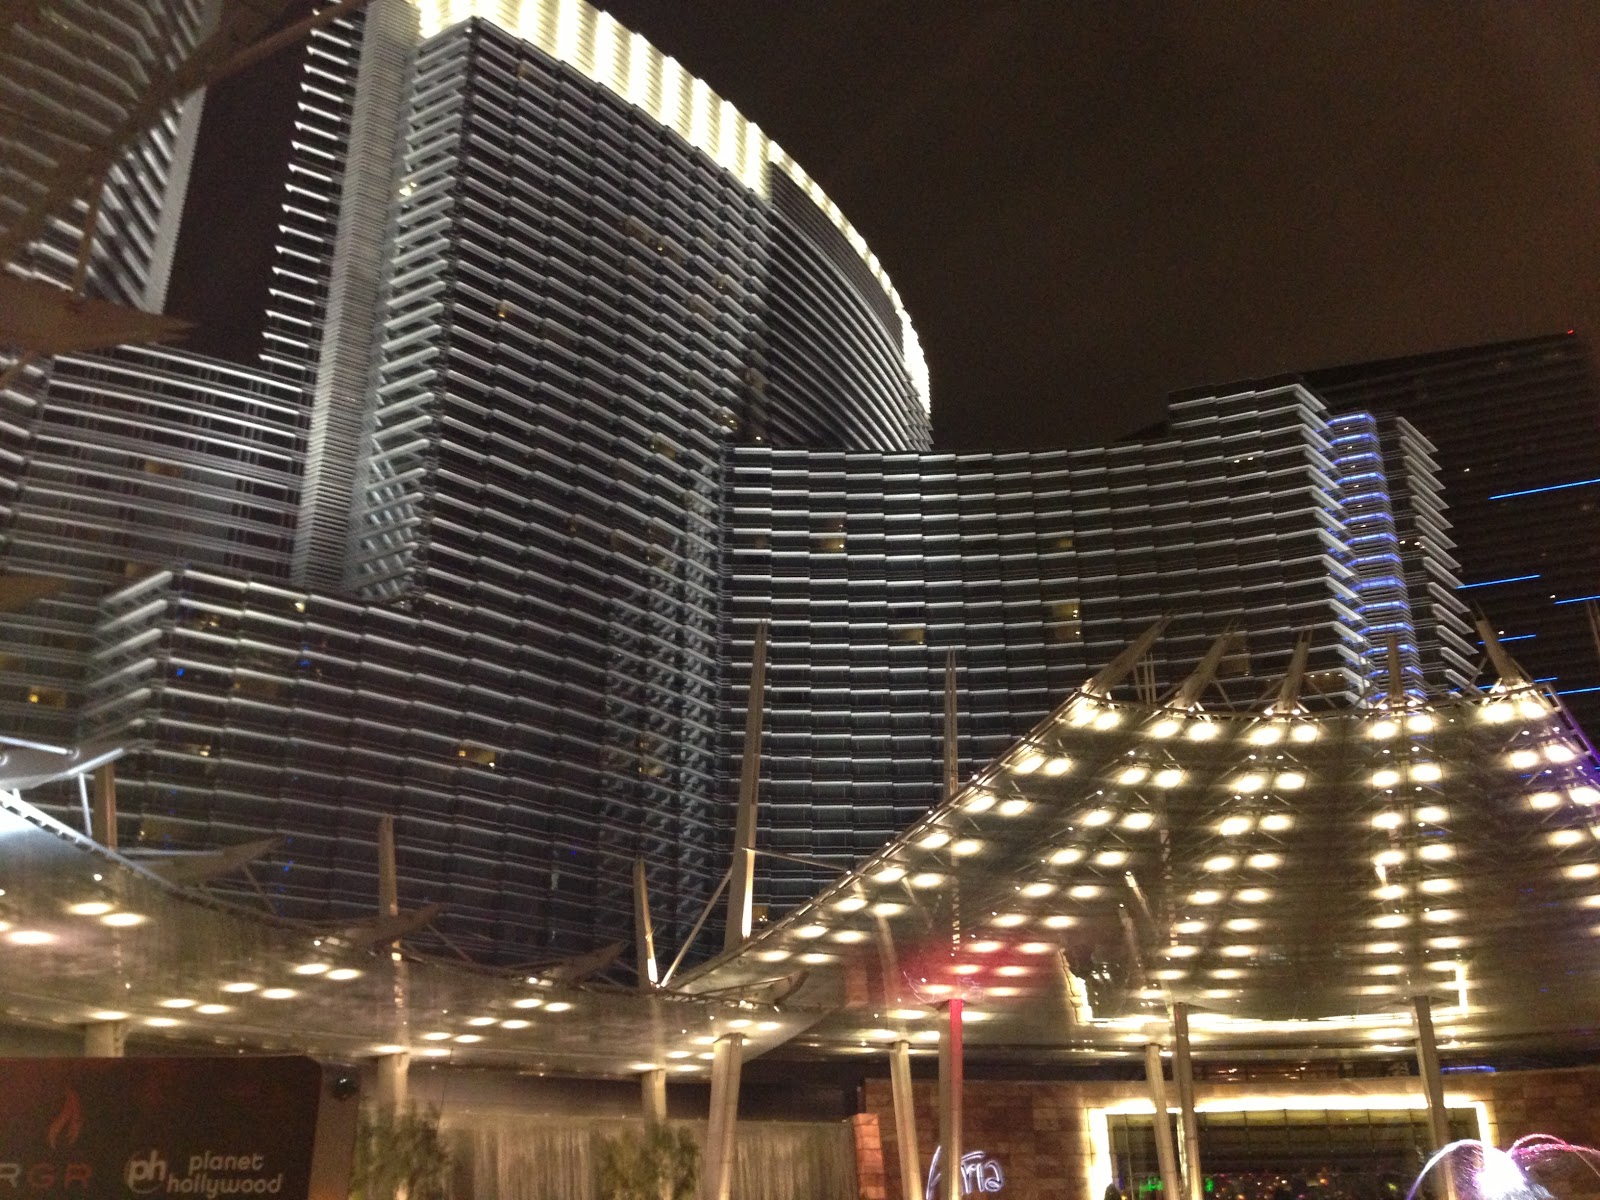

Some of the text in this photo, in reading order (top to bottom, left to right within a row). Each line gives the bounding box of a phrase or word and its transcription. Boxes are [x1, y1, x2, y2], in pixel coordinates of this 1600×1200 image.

[126, 1150, 168, 1194] ph
[188, 1150, 264, 1175] planet
[166, 1173, 283, 1199] hollywood
